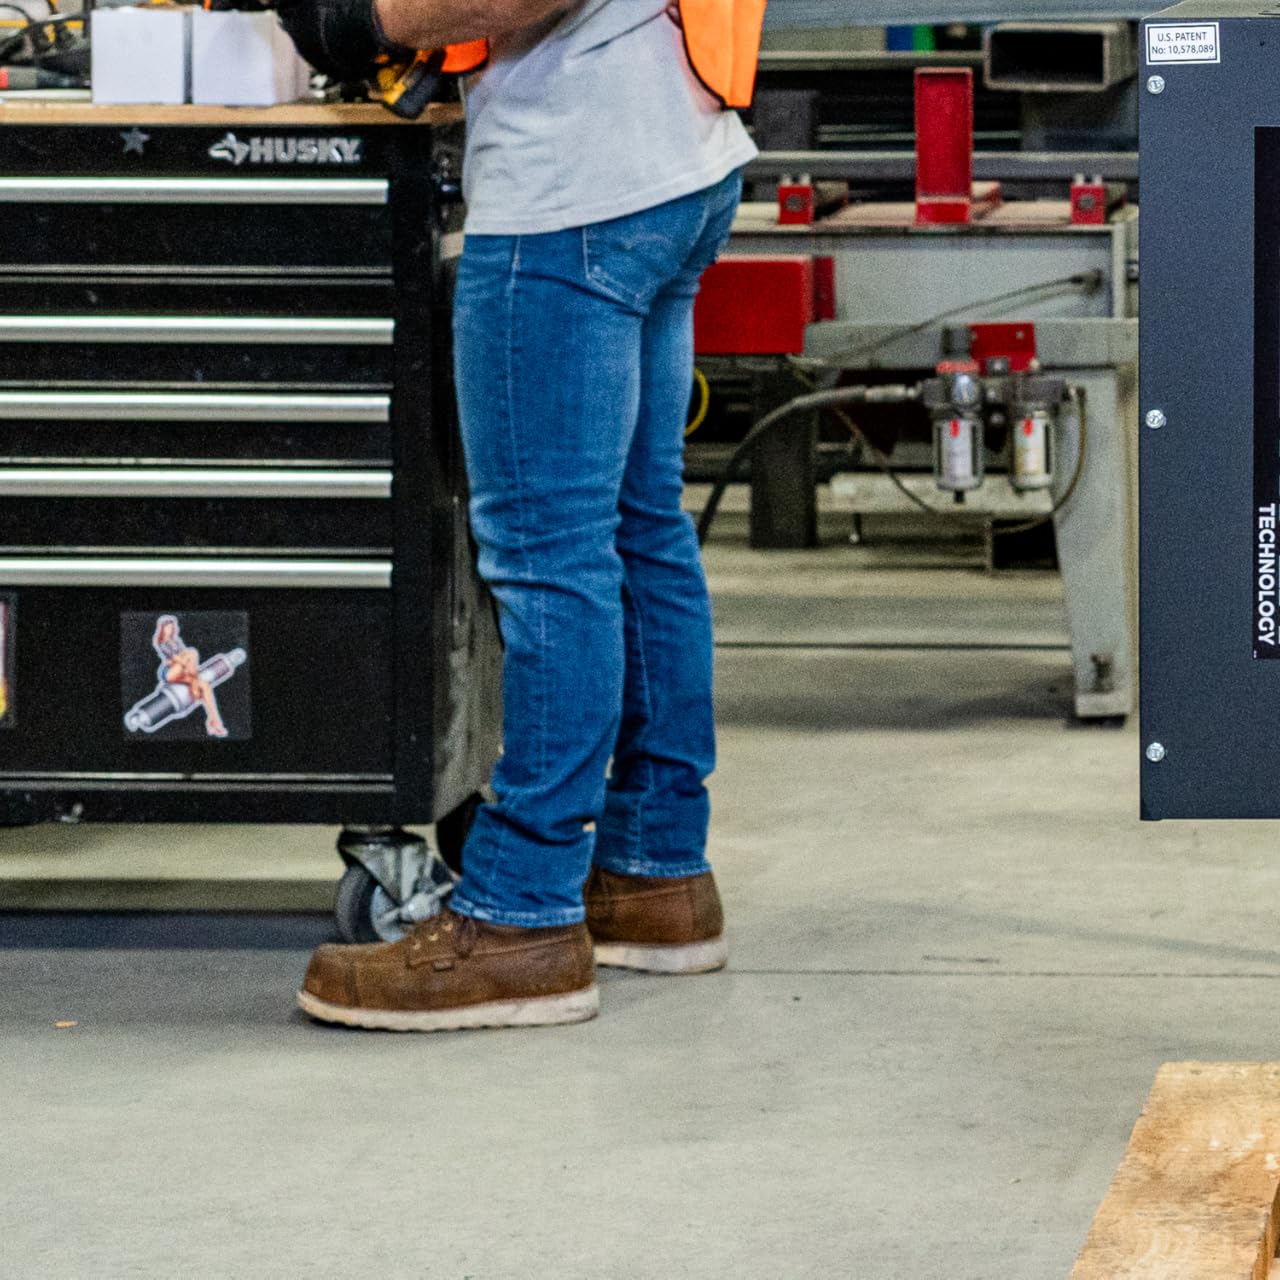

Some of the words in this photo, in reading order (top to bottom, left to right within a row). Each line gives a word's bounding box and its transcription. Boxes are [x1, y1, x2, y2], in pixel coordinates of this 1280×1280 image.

[1157, 32, 1174, 42] U.S.
[1175, 32, 1207, 41] PATENT
[1152, 46, 1166, 54] No:
[1168, 44, 1214, 54] 10,578,089
[250, 137, 361, 163] HUSKY
[1258, 503, 1276, 646] TECHNOLOGY
